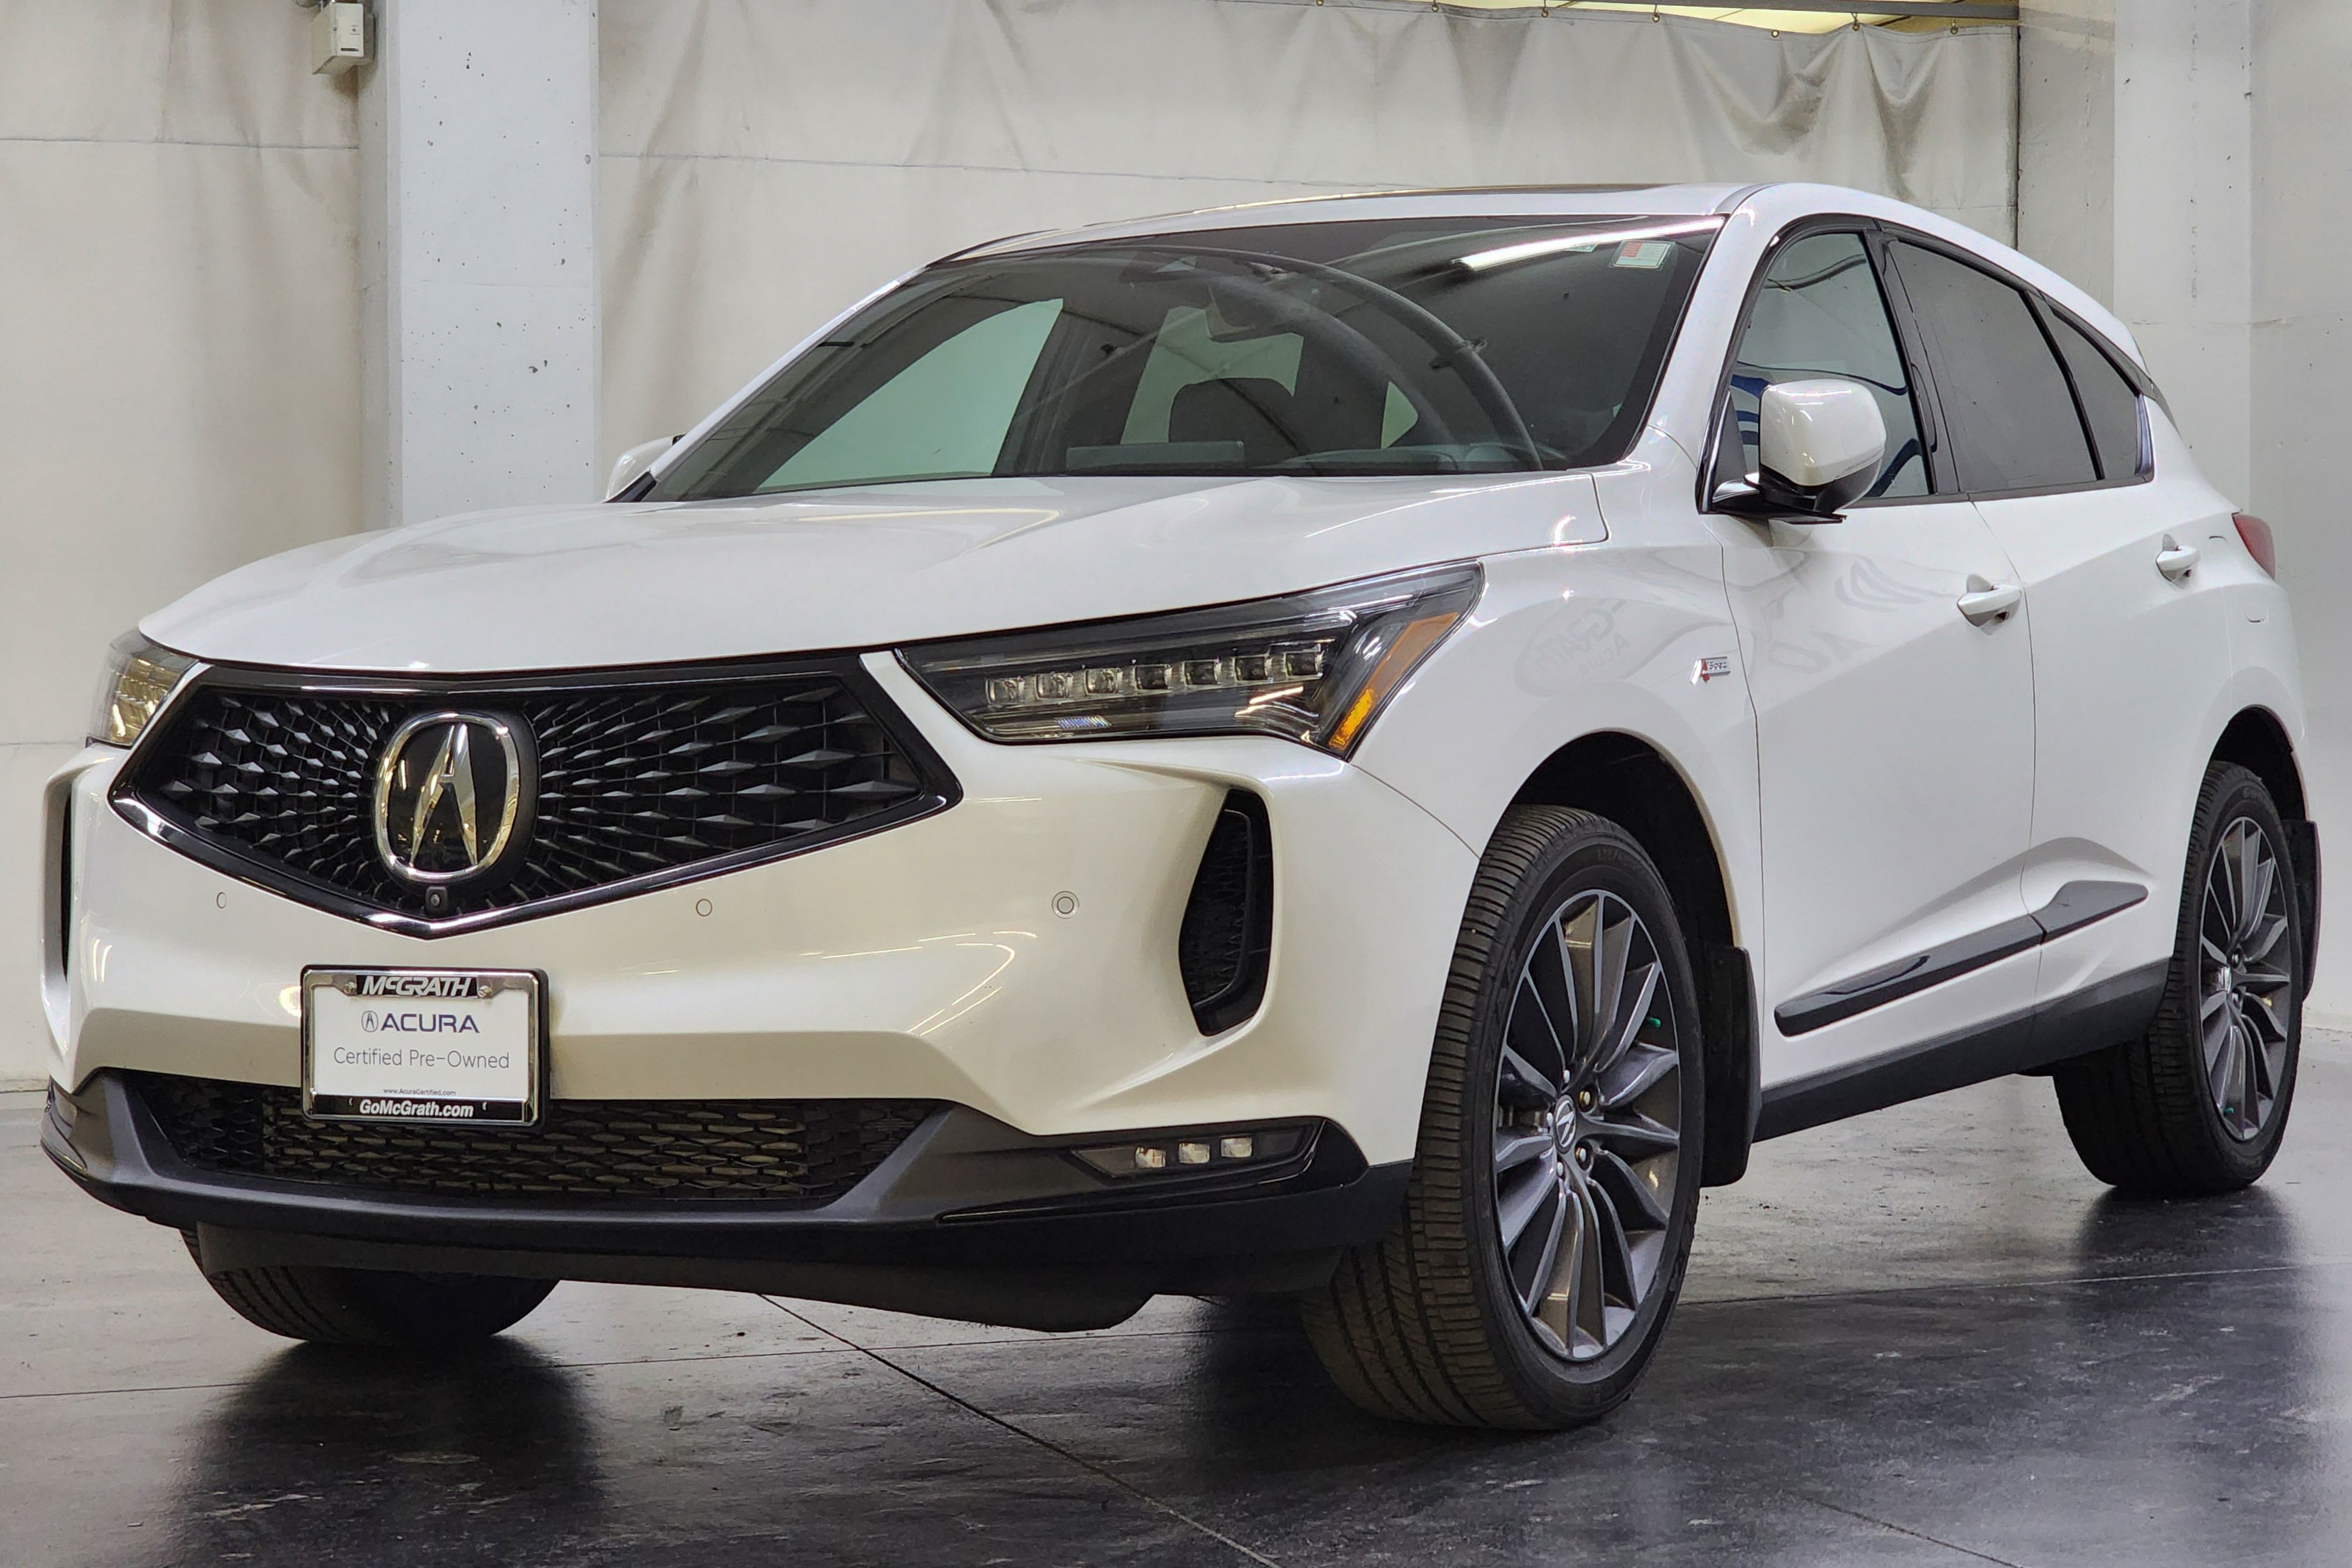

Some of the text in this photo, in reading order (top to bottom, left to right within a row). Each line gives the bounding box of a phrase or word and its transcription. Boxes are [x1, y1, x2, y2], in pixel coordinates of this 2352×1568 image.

[380, 1013, 480, 1034] ACURA
[334, 1047, 509, 1068] Certified Pre-Owned
[383, 1088, 456, 1096] www.AcuraCertified.com
[359, 1099, 474, 1118] GoMcGrath.com
